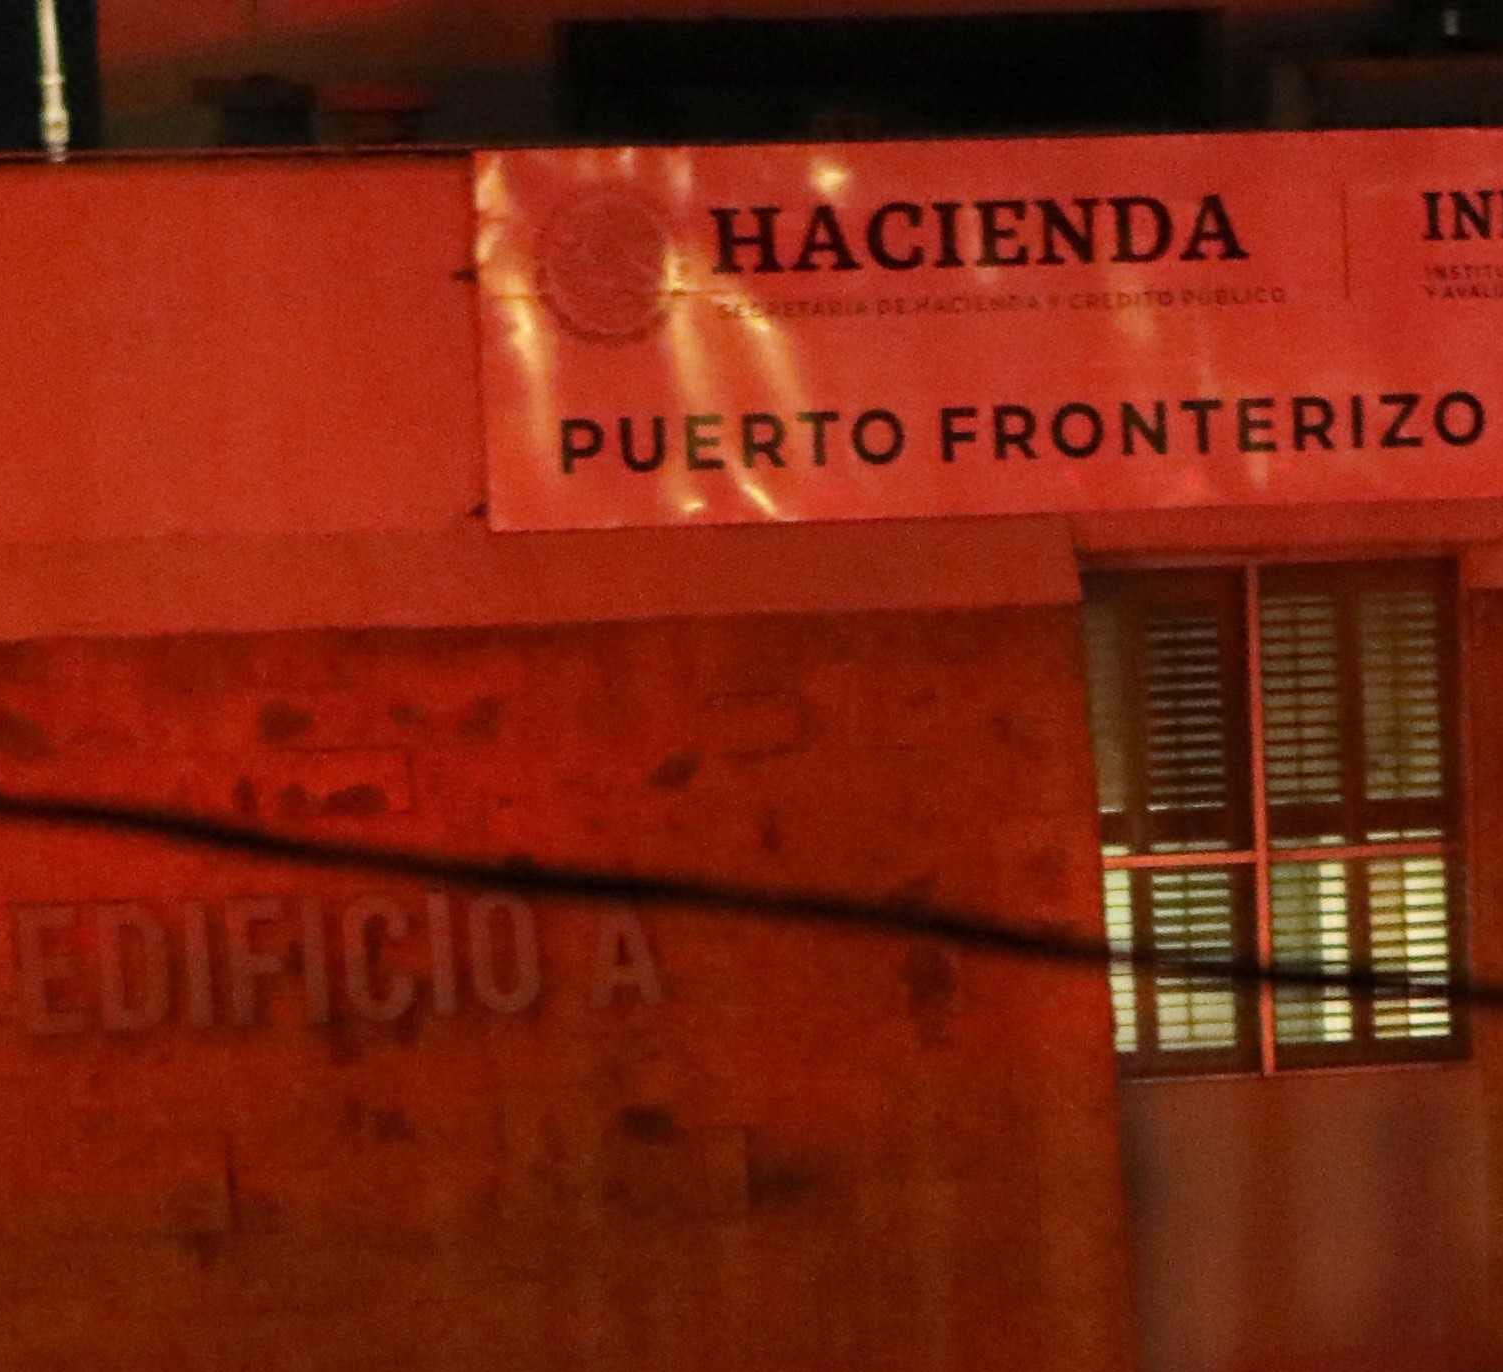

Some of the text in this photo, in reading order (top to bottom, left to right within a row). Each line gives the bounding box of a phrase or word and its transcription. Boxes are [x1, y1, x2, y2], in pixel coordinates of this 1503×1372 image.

[710, 194, 1249, 275] HACIENDA
[560, 409, 905, 474] PUERTO
[939, 390, 1486, 462] FRONTERIZO
[16, 888, 662, 1037] EDIFICIO A
